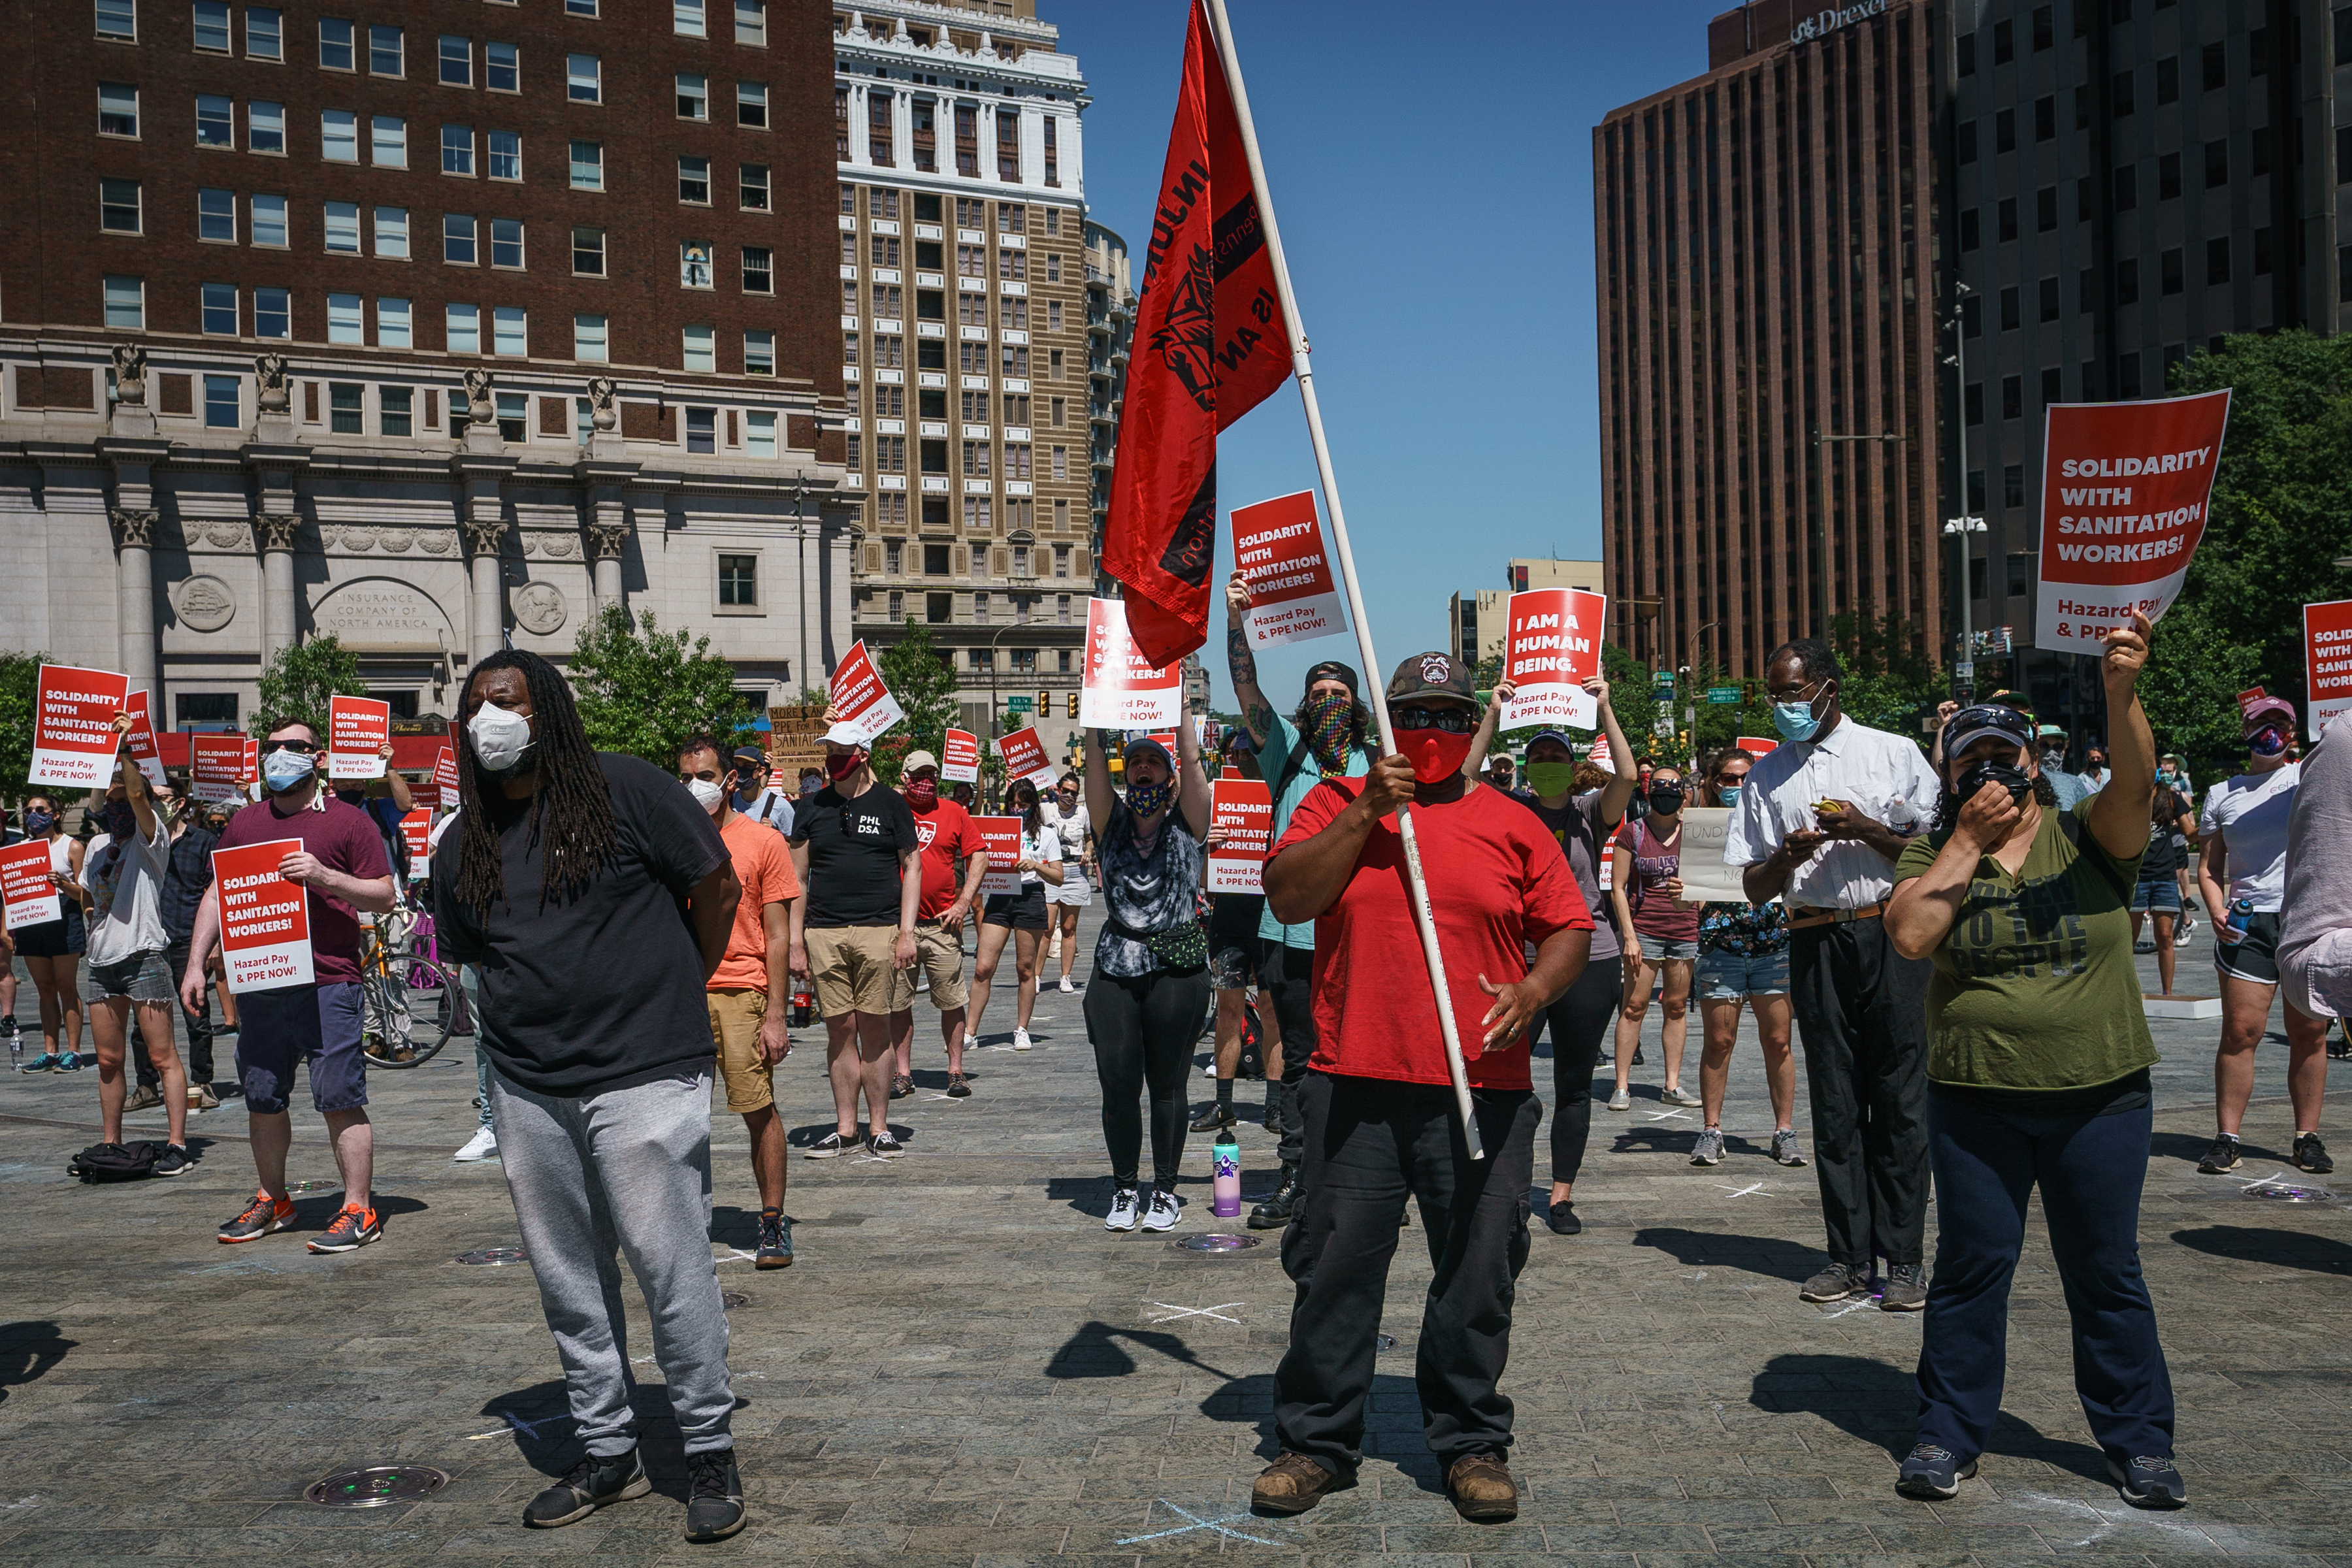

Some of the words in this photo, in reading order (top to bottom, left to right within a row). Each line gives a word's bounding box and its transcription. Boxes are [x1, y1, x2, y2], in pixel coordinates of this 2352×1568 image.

[1818, 0, 1887, 36] Drexel
[2061, 446, 2211, 478] SOLIDARITY
[2060, 487, 2132, 506] WITH
[2059, 502, 2202, 534] SANITATION
[1239, 521, 1311, 549] SOLIDARITY
[1240, 547, 1272, 564] WITH
[2057, 534, 2185, 563] WORKERS!
[1241, 554, 1321, 581] SANITATION
[1247, 572, 1315, 595] WORKERS!
[343, 594, 413, 602] INSURANCE
[338, 606, 396, 615] COMPANY
[2058, 599, 2132, 618] Hazard
[2138, 596, 2163, 613] Pay
[1254, 610, 1293, 627] Hazard
[1295, 608, 1316, 618] Pay
[1516, 618, 1522, 632] I
[1526, 613, 1559, 630] AM
[1563, 615, 1579, 630] A
[1258, 631, 1268, 640] &
[1269, 625, 1292, 638] PPE
[1293, 617, 1327, 632] NOW!
[2057, 622, 2073, 638] &
[2080, 625, 2120, 640] PP
[1515, 635, 1590, 654] HUMAN
[2315, 645, 2351, 658] WITH
[1513, 657, 1577, 676] BEING.
[832, 656, 864, 694] SOLIDARITY
[46, 690, 120, 706] SOLIDARITY
[833, 683, 848, 701] WITH
[834, 673, 875, 710] SANITATION
[1511, 693, 1547, 706] Hazard
[1551, 692, 1572, 704] Pay
[45, 703, 77, 715] WITH
[838, 686, 875, 719] WORKERS!
[1137, 700, 1156, 710] Pay
[335, 712, 384, 723] SOLIDARITY
[771, 708, 798, 719] MORE
[871, 709, 883, 719] Pay
[1130, 711, 1162, 721] NOW!
[1510, 711, 1517, 719] &
[1521, 706, 1540, 717] PPE
[1543, 706, 1578, 717] NOW!
[392, 723, 422, 732] Phoenix
[774, 721, 792, 732] PPE
[797, 722, 810, 731] FOR
[873, 713, 892, 729] NOW!
[43, 730, 106, 744] WORKERS!
[335, 731, 384, 740] SANITATION
[948, 738, 975, 747] SOLIDARITY
[1010, 743, 1023, 753] AM
[42, 757, 74, 767] Hazard
[77, 761, 93, 770] Pay
[1008, 748, 1039, 765] HUMAN
[50, 770, 67, 778] PPE
[1013, 759, 1039, 774] BEING.
[1036, 778, 1050, 787] NOW!
[1217, 802, 1272, 814] SOLIDARIT
[859, 815, 881, 826] PHL
[1217, 815, 1245, 825] WITH
[858, 825, 879, 835] DSA
[1684, 822, 1723, 839] FUND
[1217, 841, 1267, 851] WORKERS
[1, 856, 46, 871] SOLIDARITY
[1217, 867, 1247, 875] Hazard
[3, 870, 22, 880] WITH
[223, 871, 286, 890] SOLIDARIT
[7, 884, 46, 898] WORKERS!
[225, 891, 256, 906] WITH
[10, 906, 29, 915] Hazard
[29, 911, 49, 919] NOW!
[227, 900, 300, 922] SANITATION
[228, 918, 292, 938] WORKERS!
[234, 956, 269, 970] Hazard
[272, 955, 289, 964] Pay
[1950, 938, 2088, 979] PEOPLE
[237, 975, 244, 983] &
[247, 971, 265, 982] PPE
[268, 966, 297, 979] NOW!
